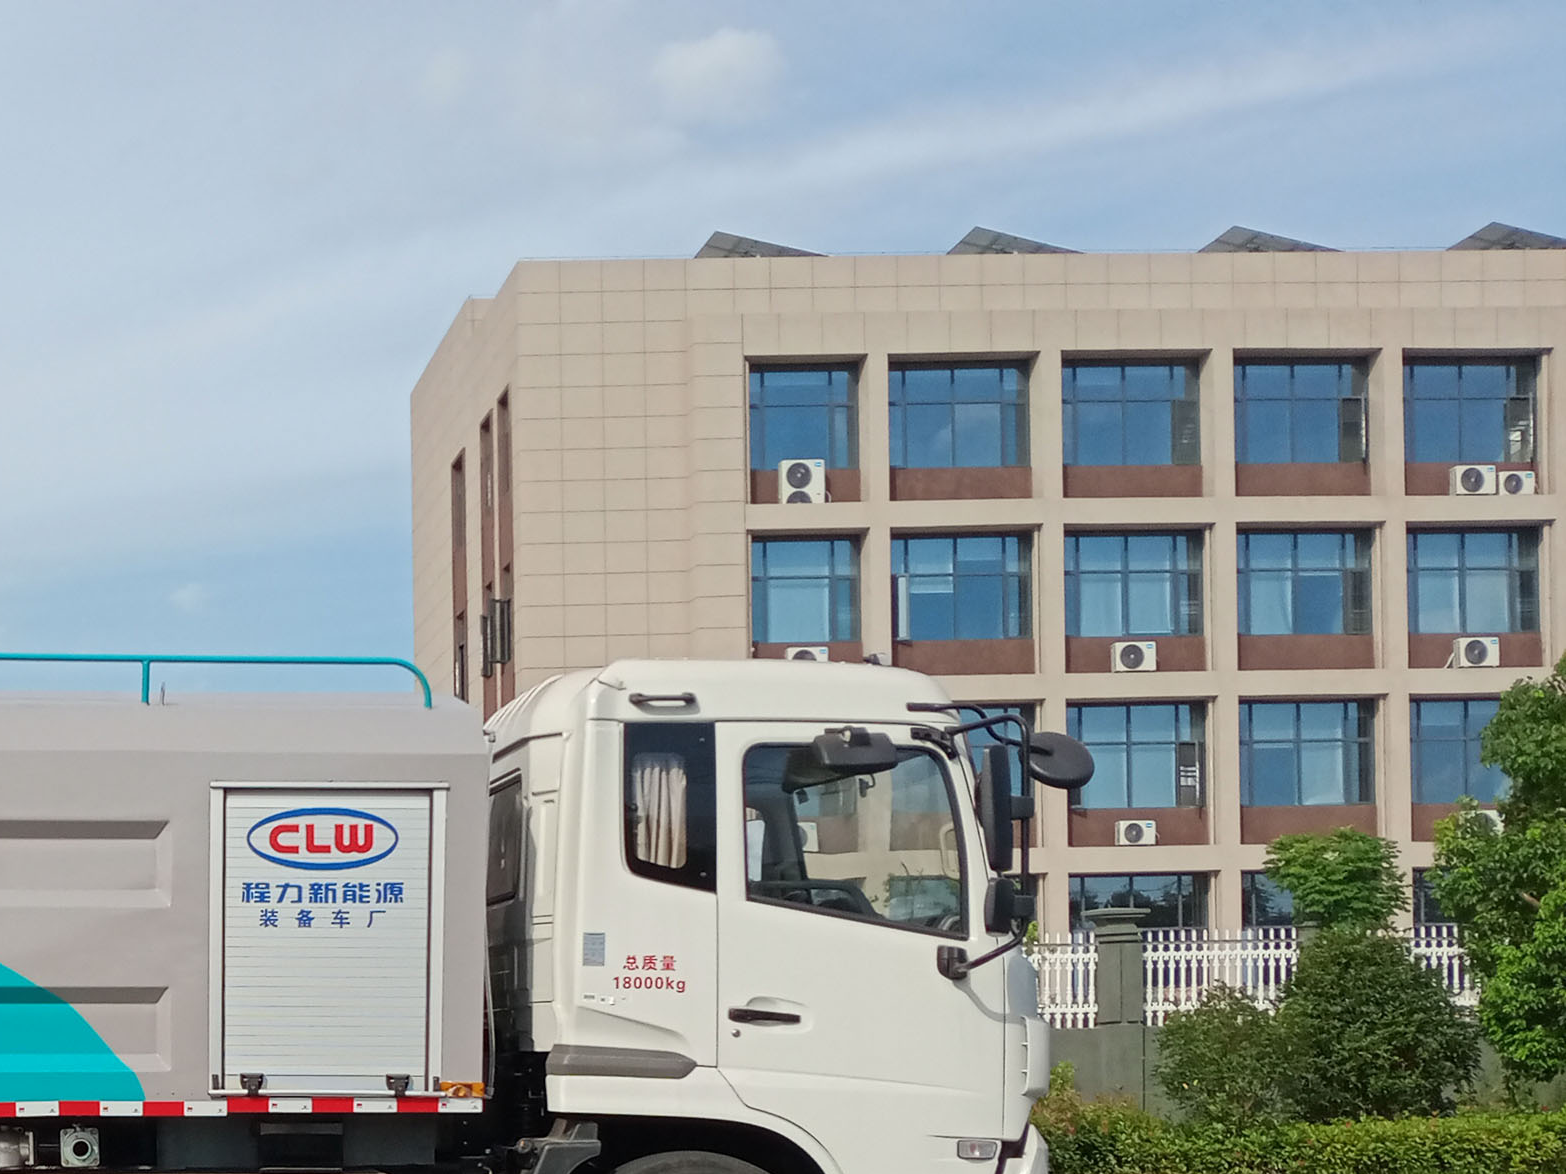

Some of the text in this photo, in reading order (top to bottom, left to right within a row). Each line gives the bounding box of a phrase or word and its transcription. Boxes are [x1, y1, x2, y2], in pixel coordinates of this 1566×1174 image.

[268, 823, 375, 854] CLW
[241, 881, 405, 904] 程力新能源
[259, 908, 387, 929] 装备车厂
[622, 954, 678, 972] 总质量
[612, 975, 687, 993] 18000kg
